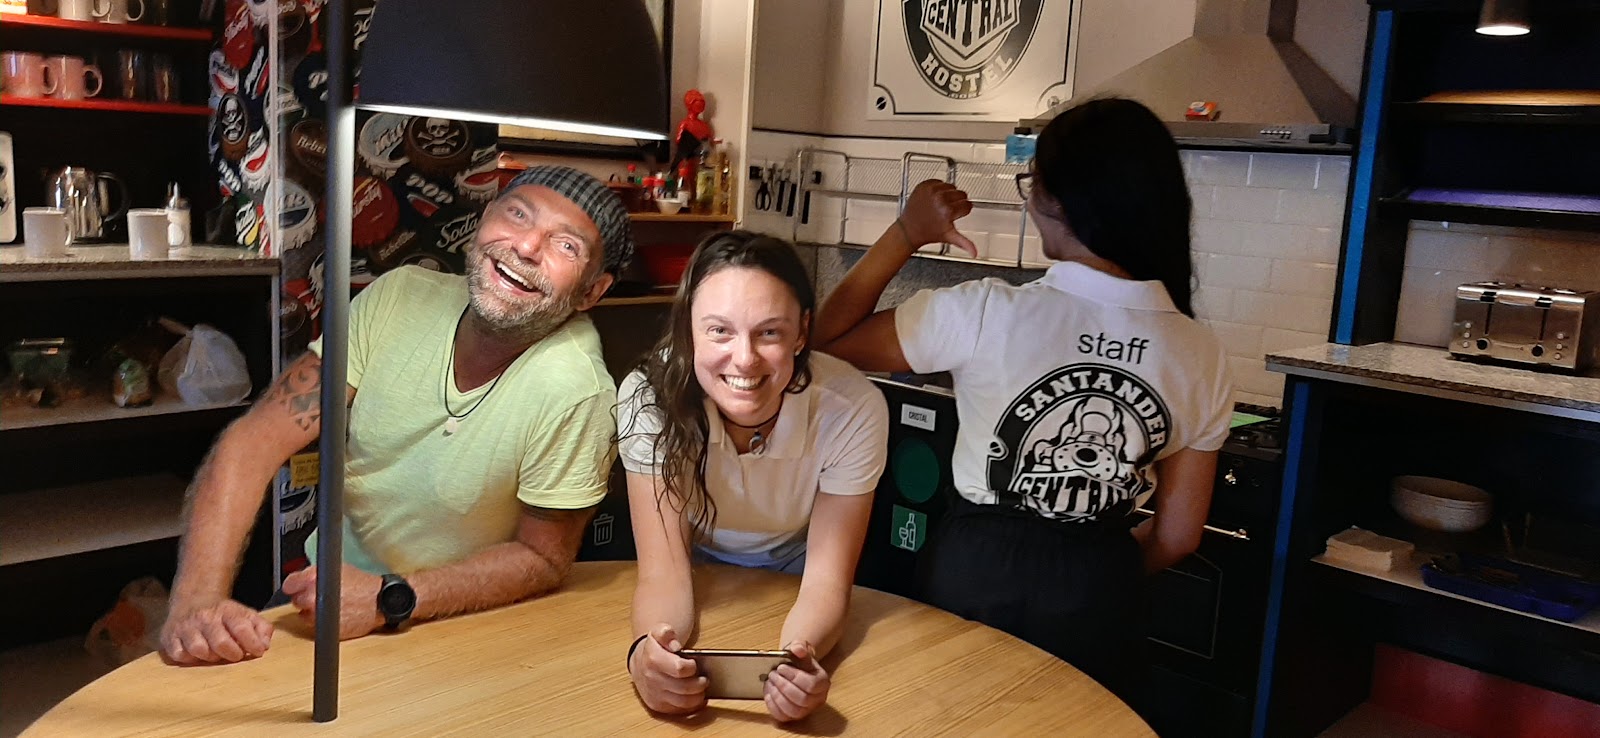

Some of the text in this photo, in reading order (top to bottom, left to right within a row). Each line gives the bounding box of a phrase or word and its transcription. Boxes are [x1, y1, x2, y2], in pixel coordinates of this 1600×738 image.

[926, 0, 1013, 47] CENTRAL
[920, 53, 1013, 93] HOSTEL
[405, 173, 454, 204] POP
[436, 212, 480, 248] Soda
[1077, 332, 1149, 364] staff
[1015, 370, 1166, 447] SANTANDER
